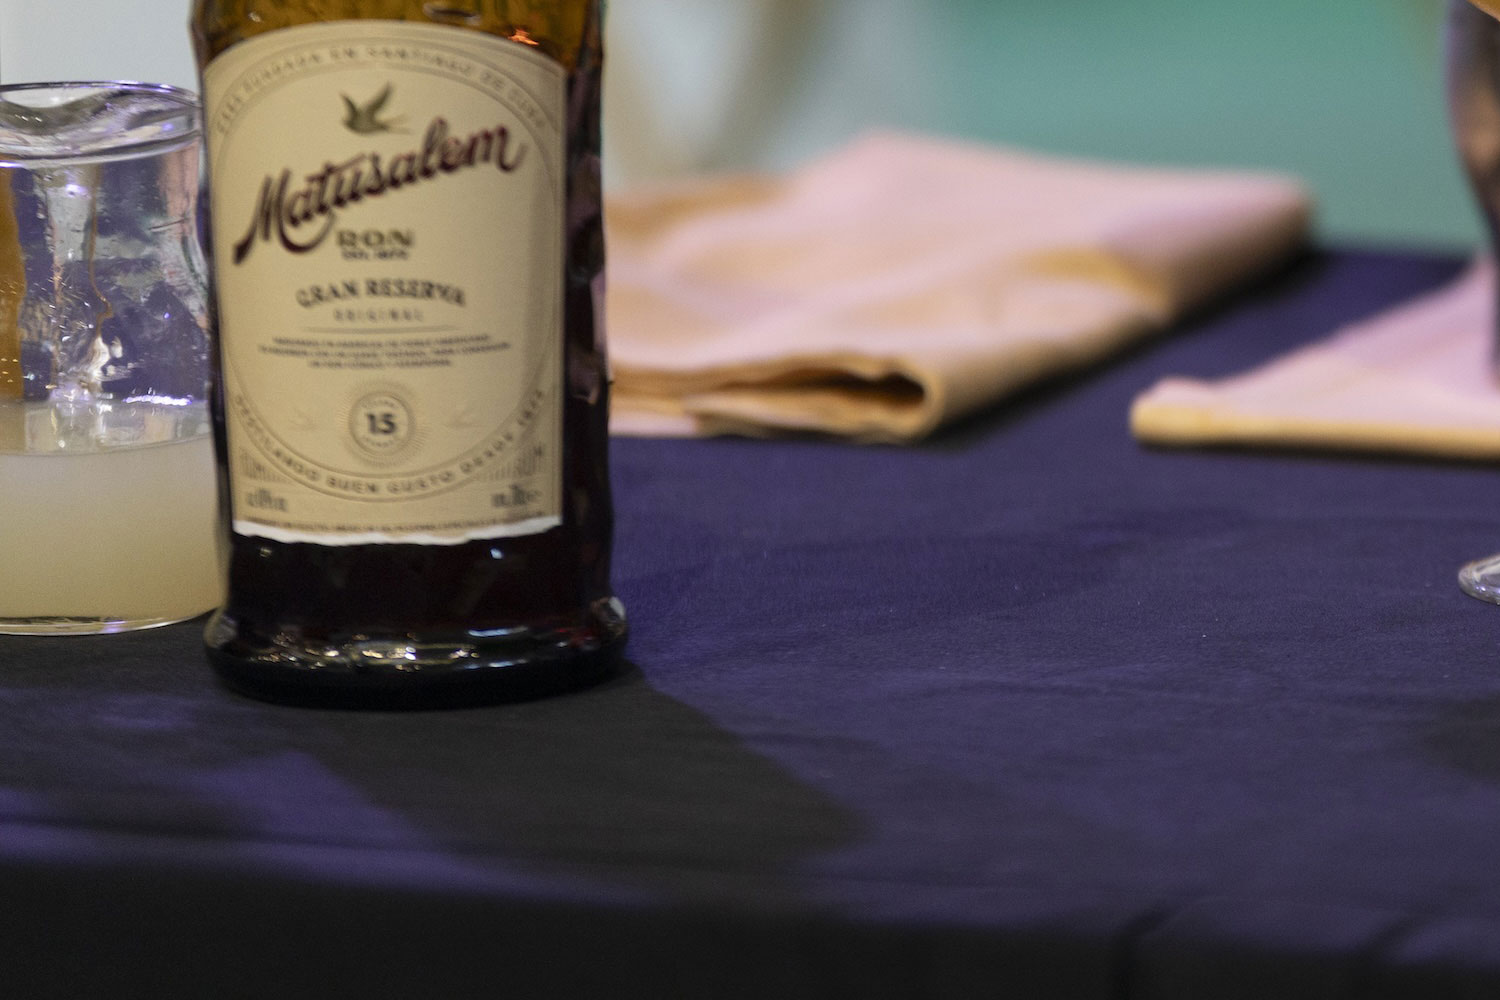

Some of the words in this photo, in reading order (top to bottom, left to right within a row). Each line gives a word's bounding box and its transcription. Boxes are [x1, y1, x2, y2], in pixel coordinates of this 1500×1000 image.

[231, 117, 529, 266] Matusalem
[337, 229, 414, 248] RON
[296, 278, 359, 308] GRAN
[366, 277, 467, 308] RESERVA
[366, 412, 398, 436] 15
[326, 474, 379, 494] BUEN
[386, 470, 453, 494] GUSTO
